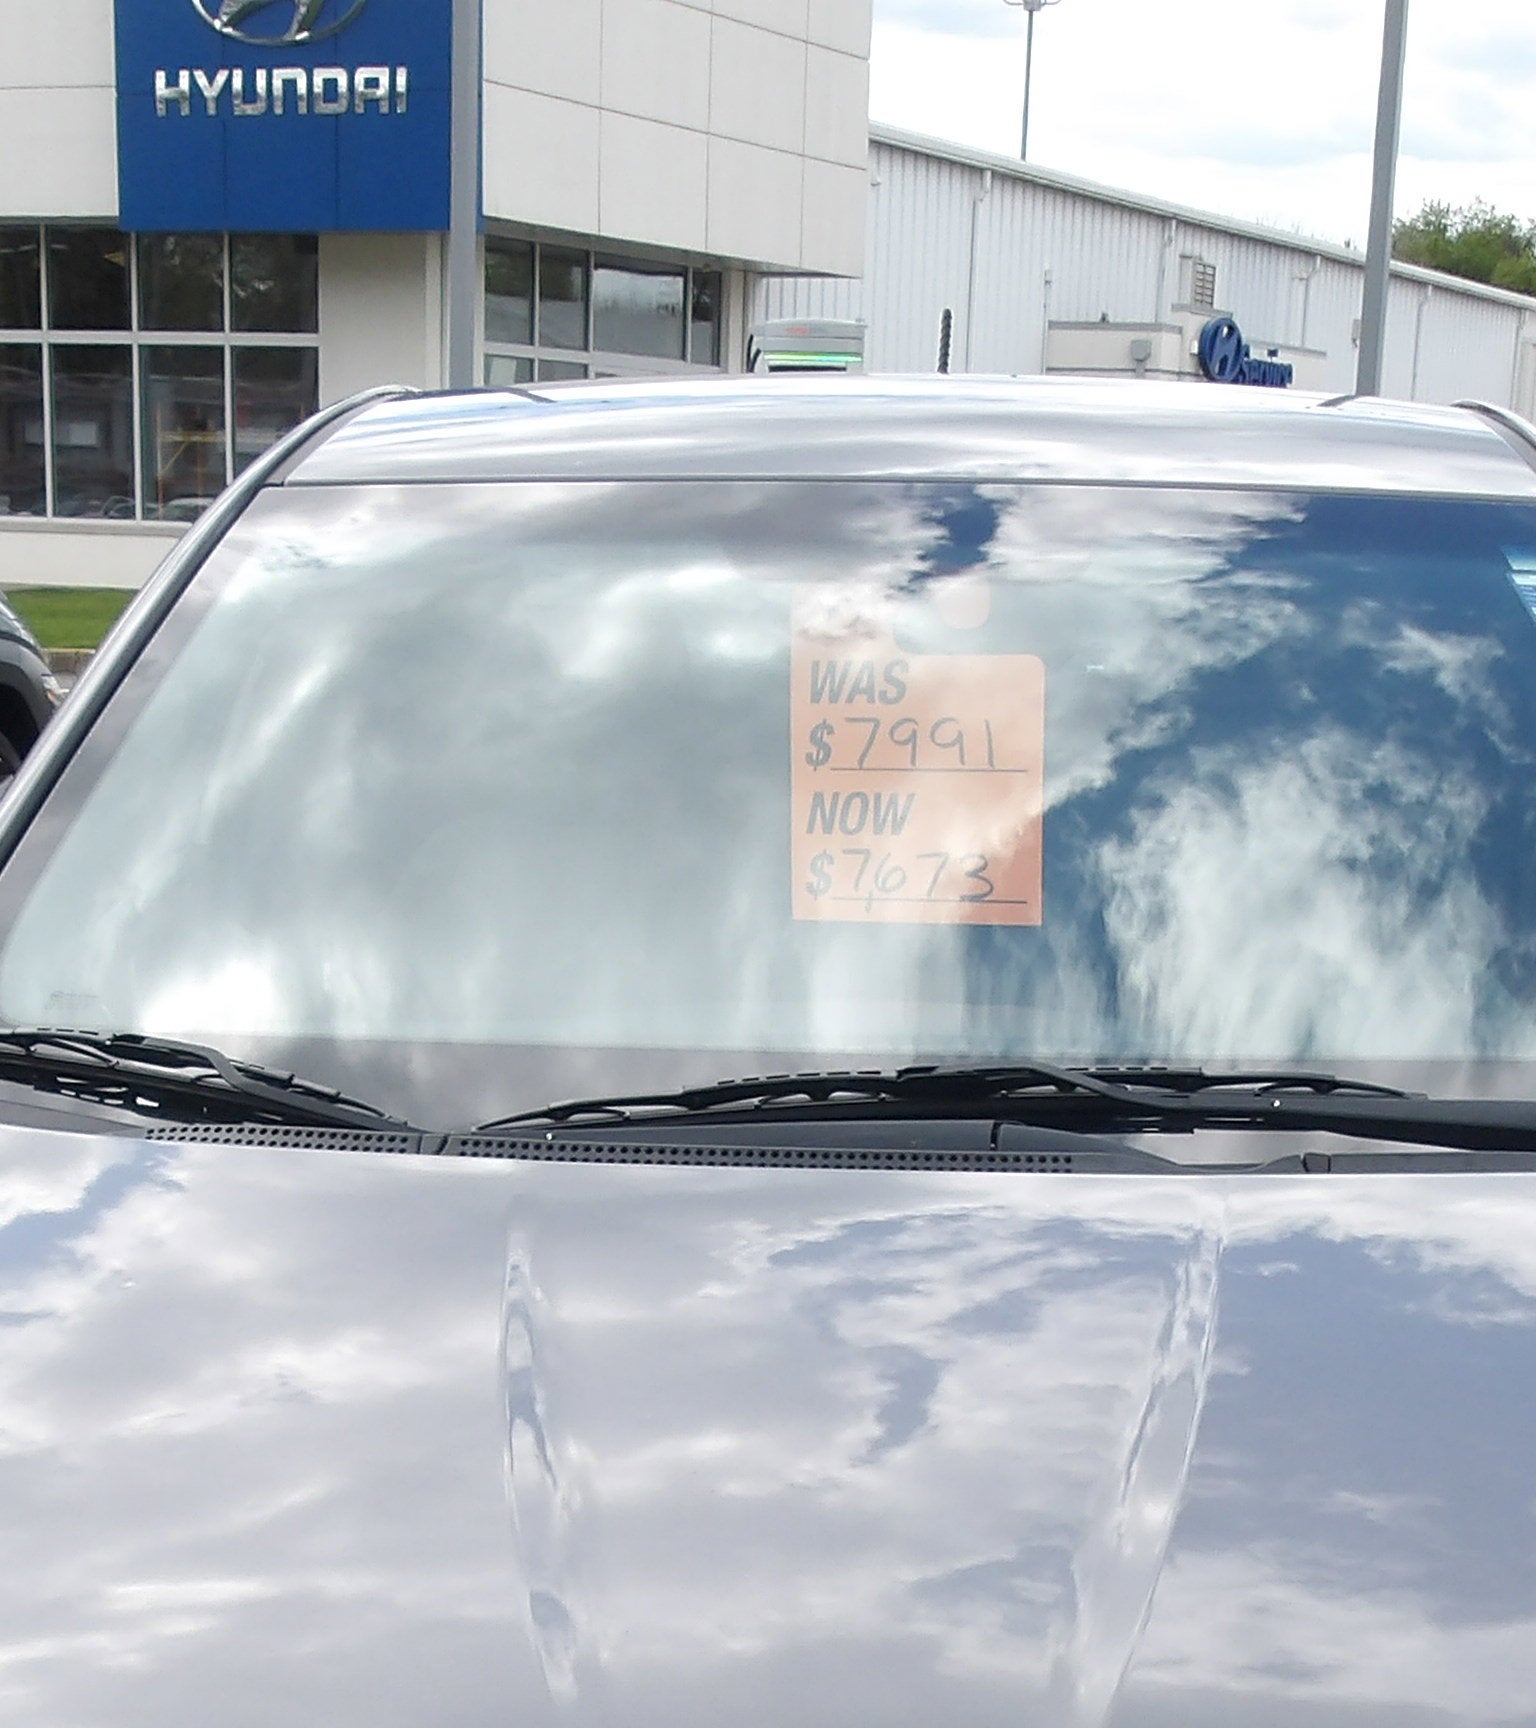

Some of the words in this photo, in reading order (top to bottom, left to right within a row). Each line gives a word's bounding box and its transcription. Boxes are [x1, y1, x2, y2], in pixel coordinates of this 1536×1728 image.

[154, 65, 407, 117] HYUNDAI
[810, 657, 910, 705] WAS
[806, 791, 916, 836] NOW
